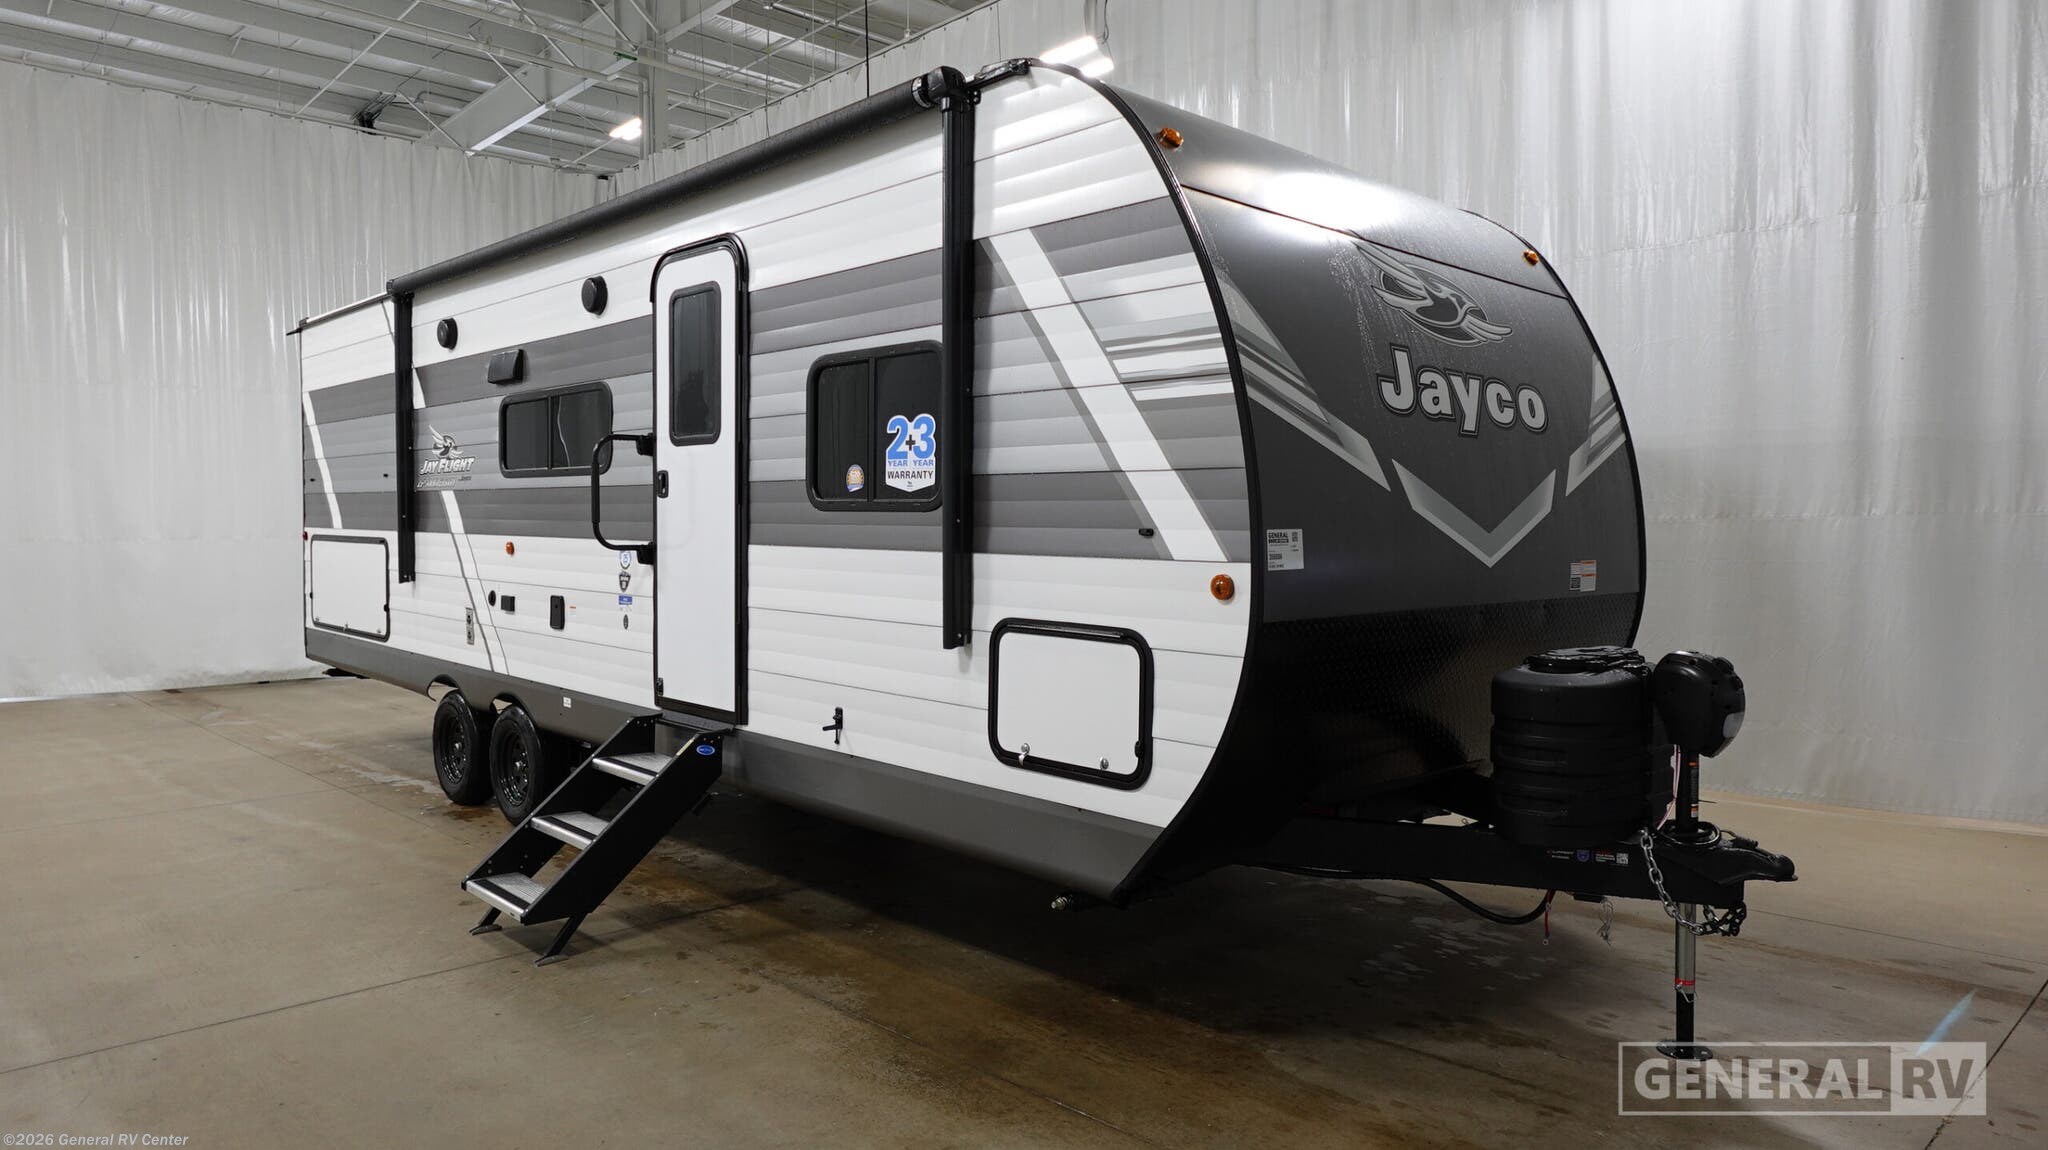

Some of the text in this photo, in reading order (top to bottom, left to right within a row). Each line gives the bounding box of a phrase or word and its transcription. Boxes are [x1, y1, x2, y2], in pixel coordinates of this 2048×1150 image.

[1378, 345, 1548, 437] Jayco
[420, 457, 475, 475] JAY FLIGHT
[888, 460, 908, 468] YEAR
[887, 470, 934, 480] WARRANTY
